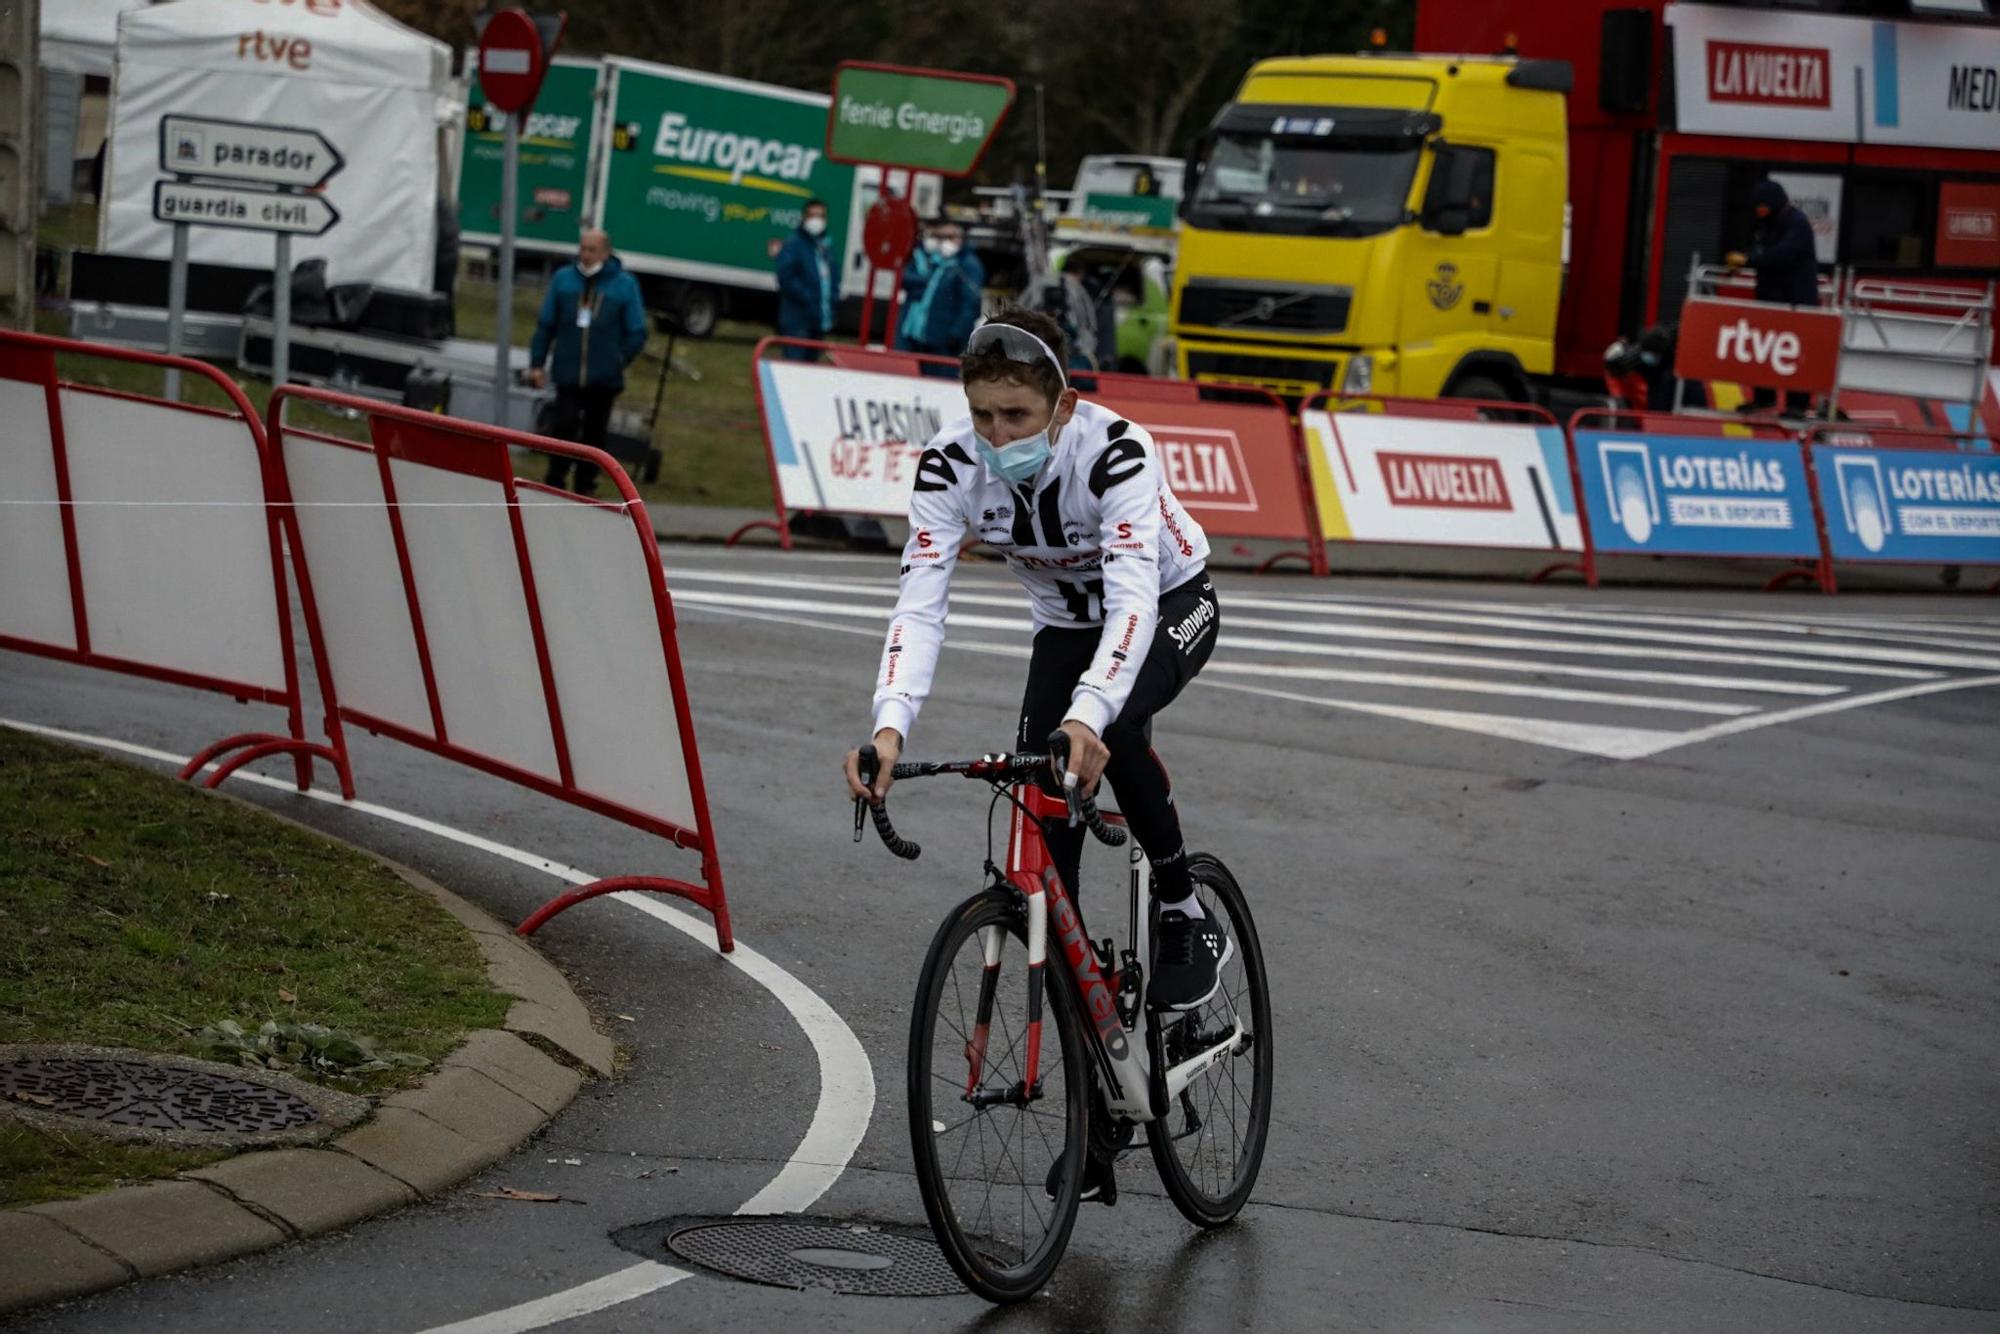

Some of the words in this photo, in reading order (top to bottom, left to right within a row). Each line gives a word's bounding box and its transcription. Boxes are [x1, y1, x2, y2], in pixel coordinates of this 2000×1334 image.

[237, 29, 312, 70] rtve
[1714, 49, 1743, 95] LA
[1744, 51, 1823, 100] VUELTA
[1947, 65, 2000, 113] MED
[214, 142, 315, 171] parador
[653, 111, 822, 185] Europcar
[164, 194, 247, 218] guardia
[261, 202, 307, 224] civil
[769, 207, 801, 230] wa
[1716, 318, 1801, 376] rtve
[833, 395, 866, 441] LA
[866, 397, 943, 448] PASIÓN
[1156, 441, 1238, 495] ELTA
[1387, 459, 1422, 500] LA
[1415, 460, 1503, 504] VUELTA
[1658, 450, 1787, 493] LOTERÍAS
[1888, 463, 2000, 502] LOTERÍAS
[1678, 503, 1705, 520] CON
[1709, 504, 1723, 520] EL
[1725, 505, 1781, 523] DEPORTE
[1118, 613, 1139, 652] Sunweb
[1167, 597, 1215, 650] Sunweb
